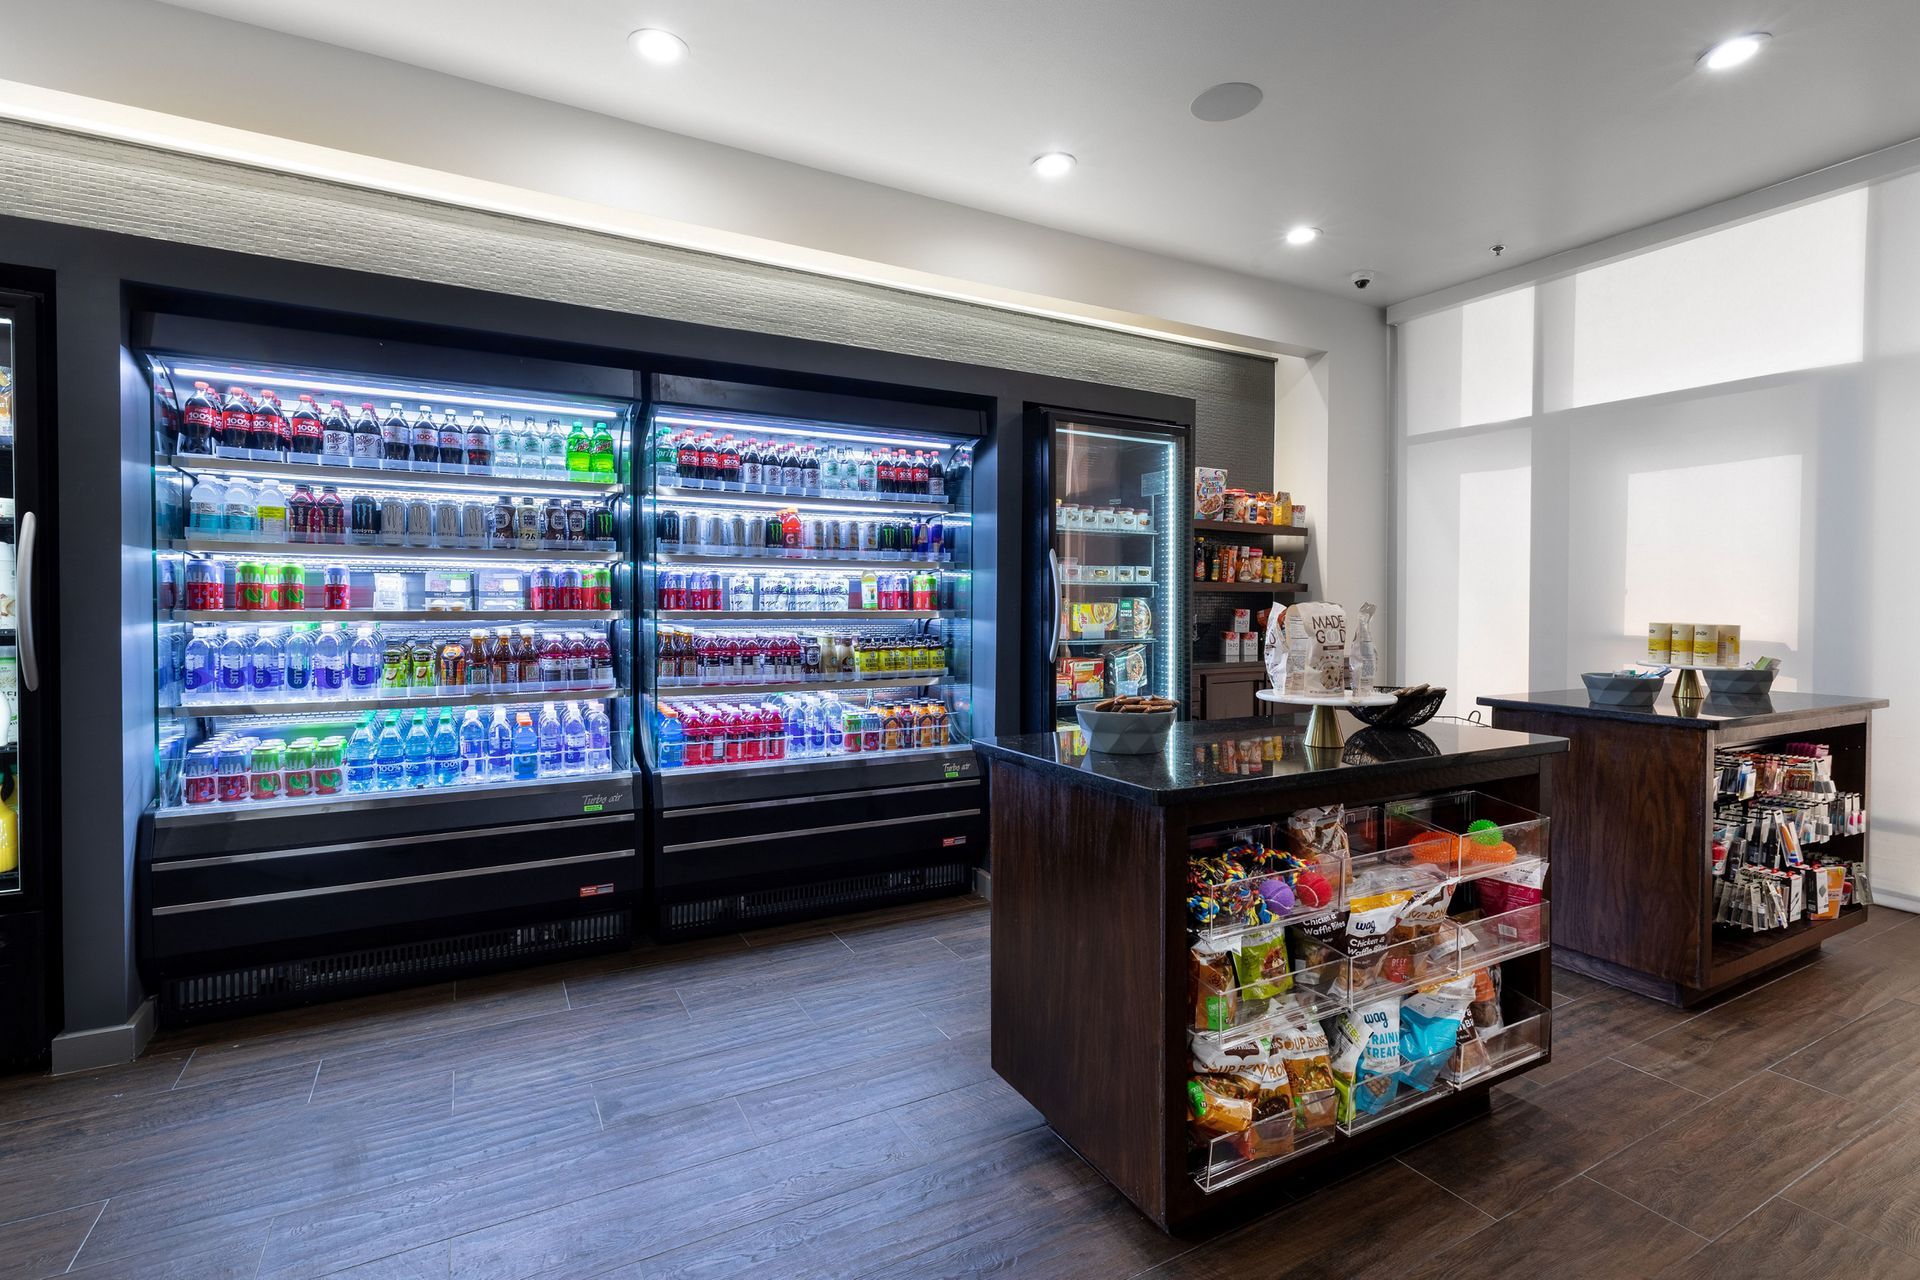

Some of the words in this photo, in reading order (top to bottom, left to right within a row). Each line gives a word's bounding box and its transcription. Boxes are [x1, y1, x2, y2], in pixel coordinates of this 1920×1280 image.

[189, 412, 213, 422] 100%
[227, 418, 250, 427] 100%
[297, 425, 319, 434] 100%
[1312, 615, 1345, 629] MADE
[252, 761, 277, 773] AHA
[943, 763, 960, 772] Turbo
[582, 793, 607, 805] Turbo
[609, 793, 623, 803] air
[1303, 923, 1332, 936] Waffle
[1331, 920, 1346, 931] Bites
[1355, 919, 1376, 934] wag
[1349, 936, 1378, 948] Chicken
[1363, 1011, 1389, 1029] wag
[1277, 1036, 1307, 1051] SOUP
